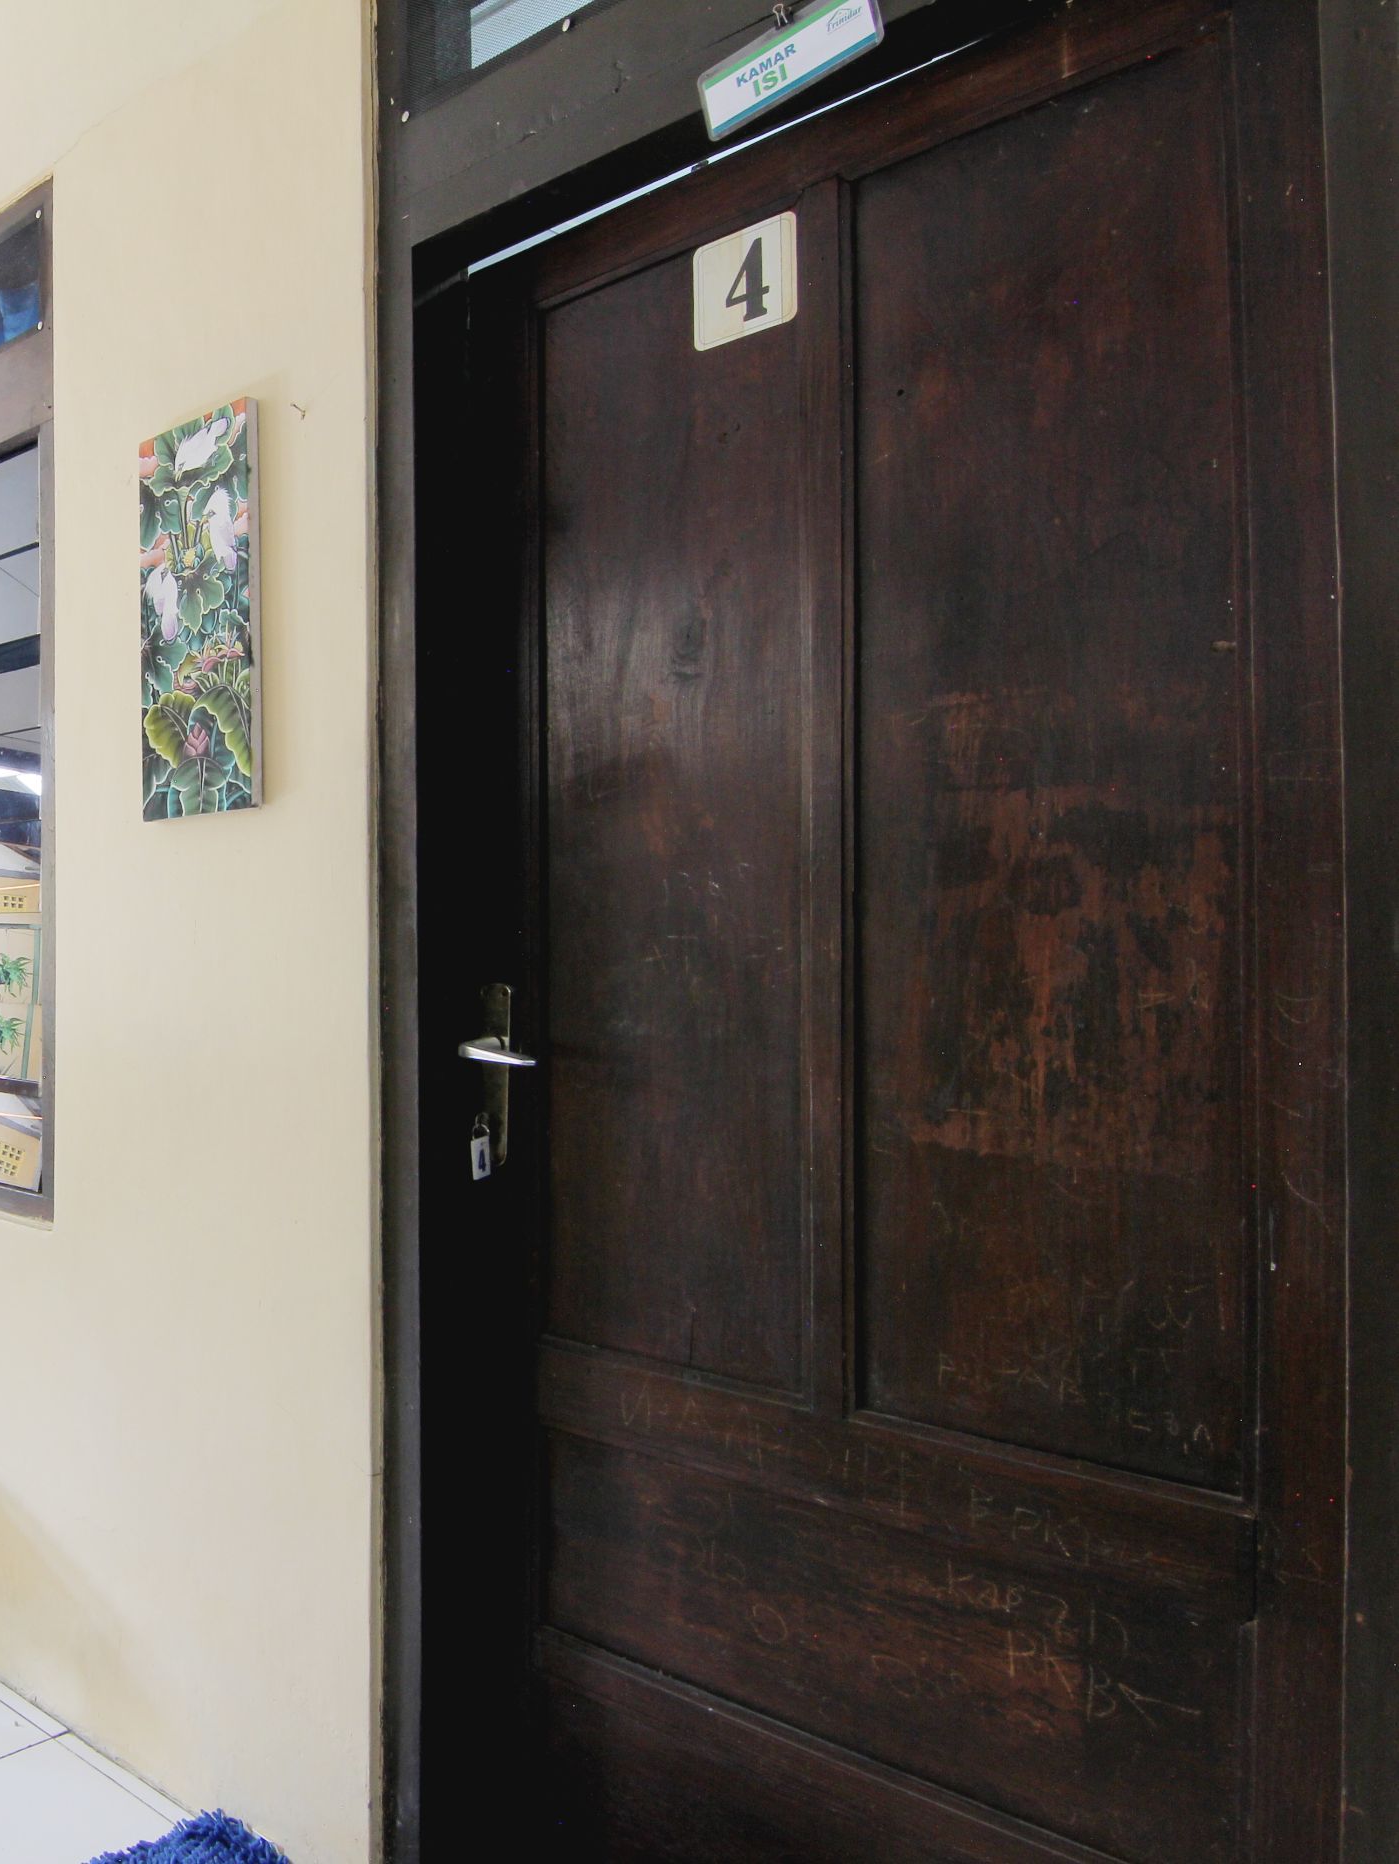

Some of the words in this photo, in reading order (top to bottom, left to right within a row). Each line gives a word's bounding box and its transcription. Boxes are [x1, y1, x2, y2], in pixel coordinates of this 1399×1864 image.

[736, 43, 796, 87] KAMAR
[753, 63, 788, 97] ISI
[725, 237, 770, 322] 4
[478, 1149, 486, 1172] 4
